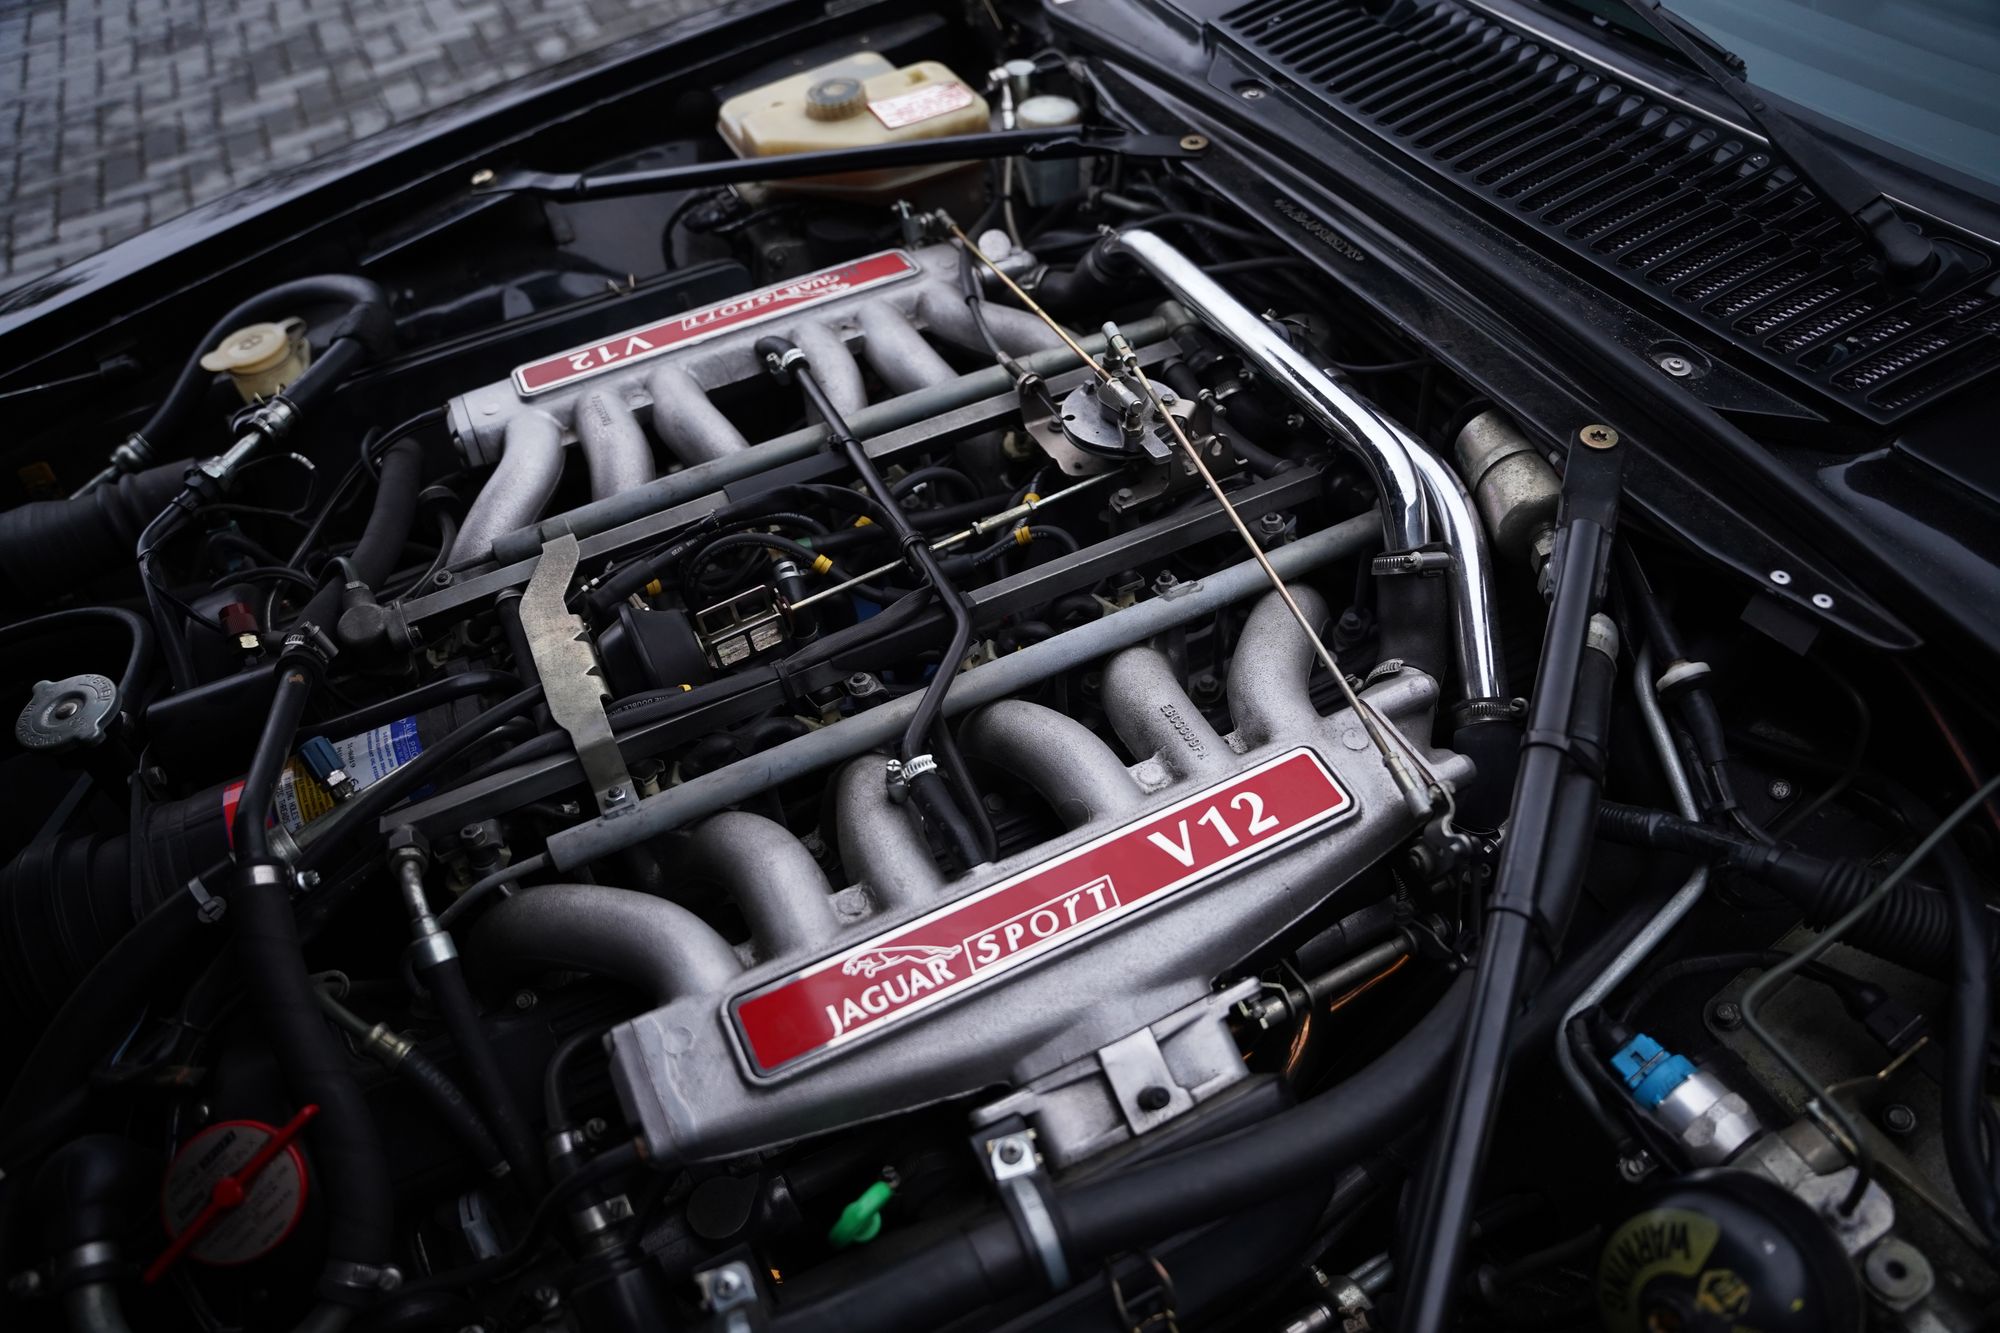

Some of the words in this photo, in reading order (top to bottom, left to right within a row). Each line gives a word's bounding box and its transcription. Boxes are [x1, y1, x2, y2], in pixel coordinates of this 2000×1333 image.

[568, 336, 654, 372] V12
[1146, 789, 1281, 868] V12
[826, 957, 958, 1037] JAGUAR
[1602, 1221, 1690, 1313] WARNING
